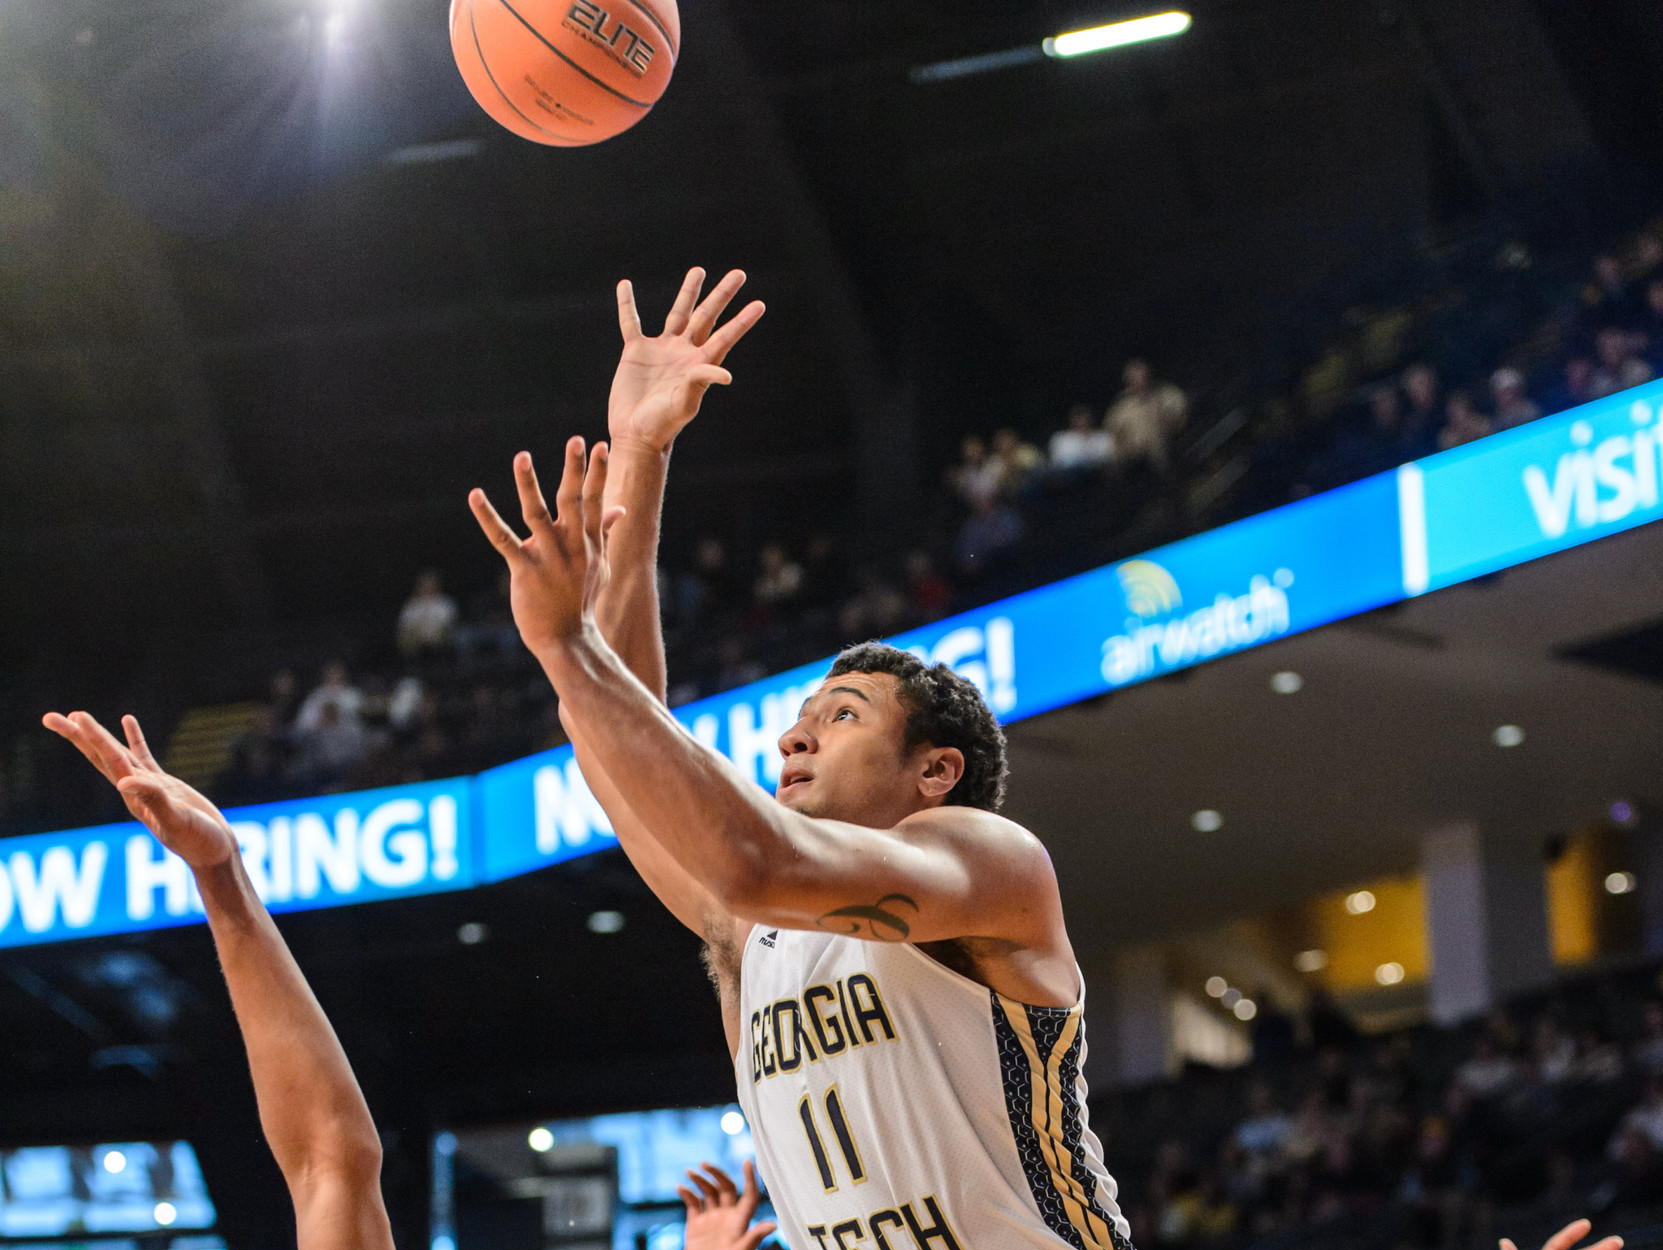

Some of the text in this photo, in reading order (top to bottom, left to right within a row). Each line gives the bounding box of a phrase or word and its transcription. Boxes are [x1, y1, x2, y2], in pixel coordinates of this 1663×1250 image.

[566, 0, 656, 75] ELITE
[125, 794, 458, 922] HRING!
[750, 971, 900, 1087] GEORGIA
[797, 1082, 868, 1195] 11
